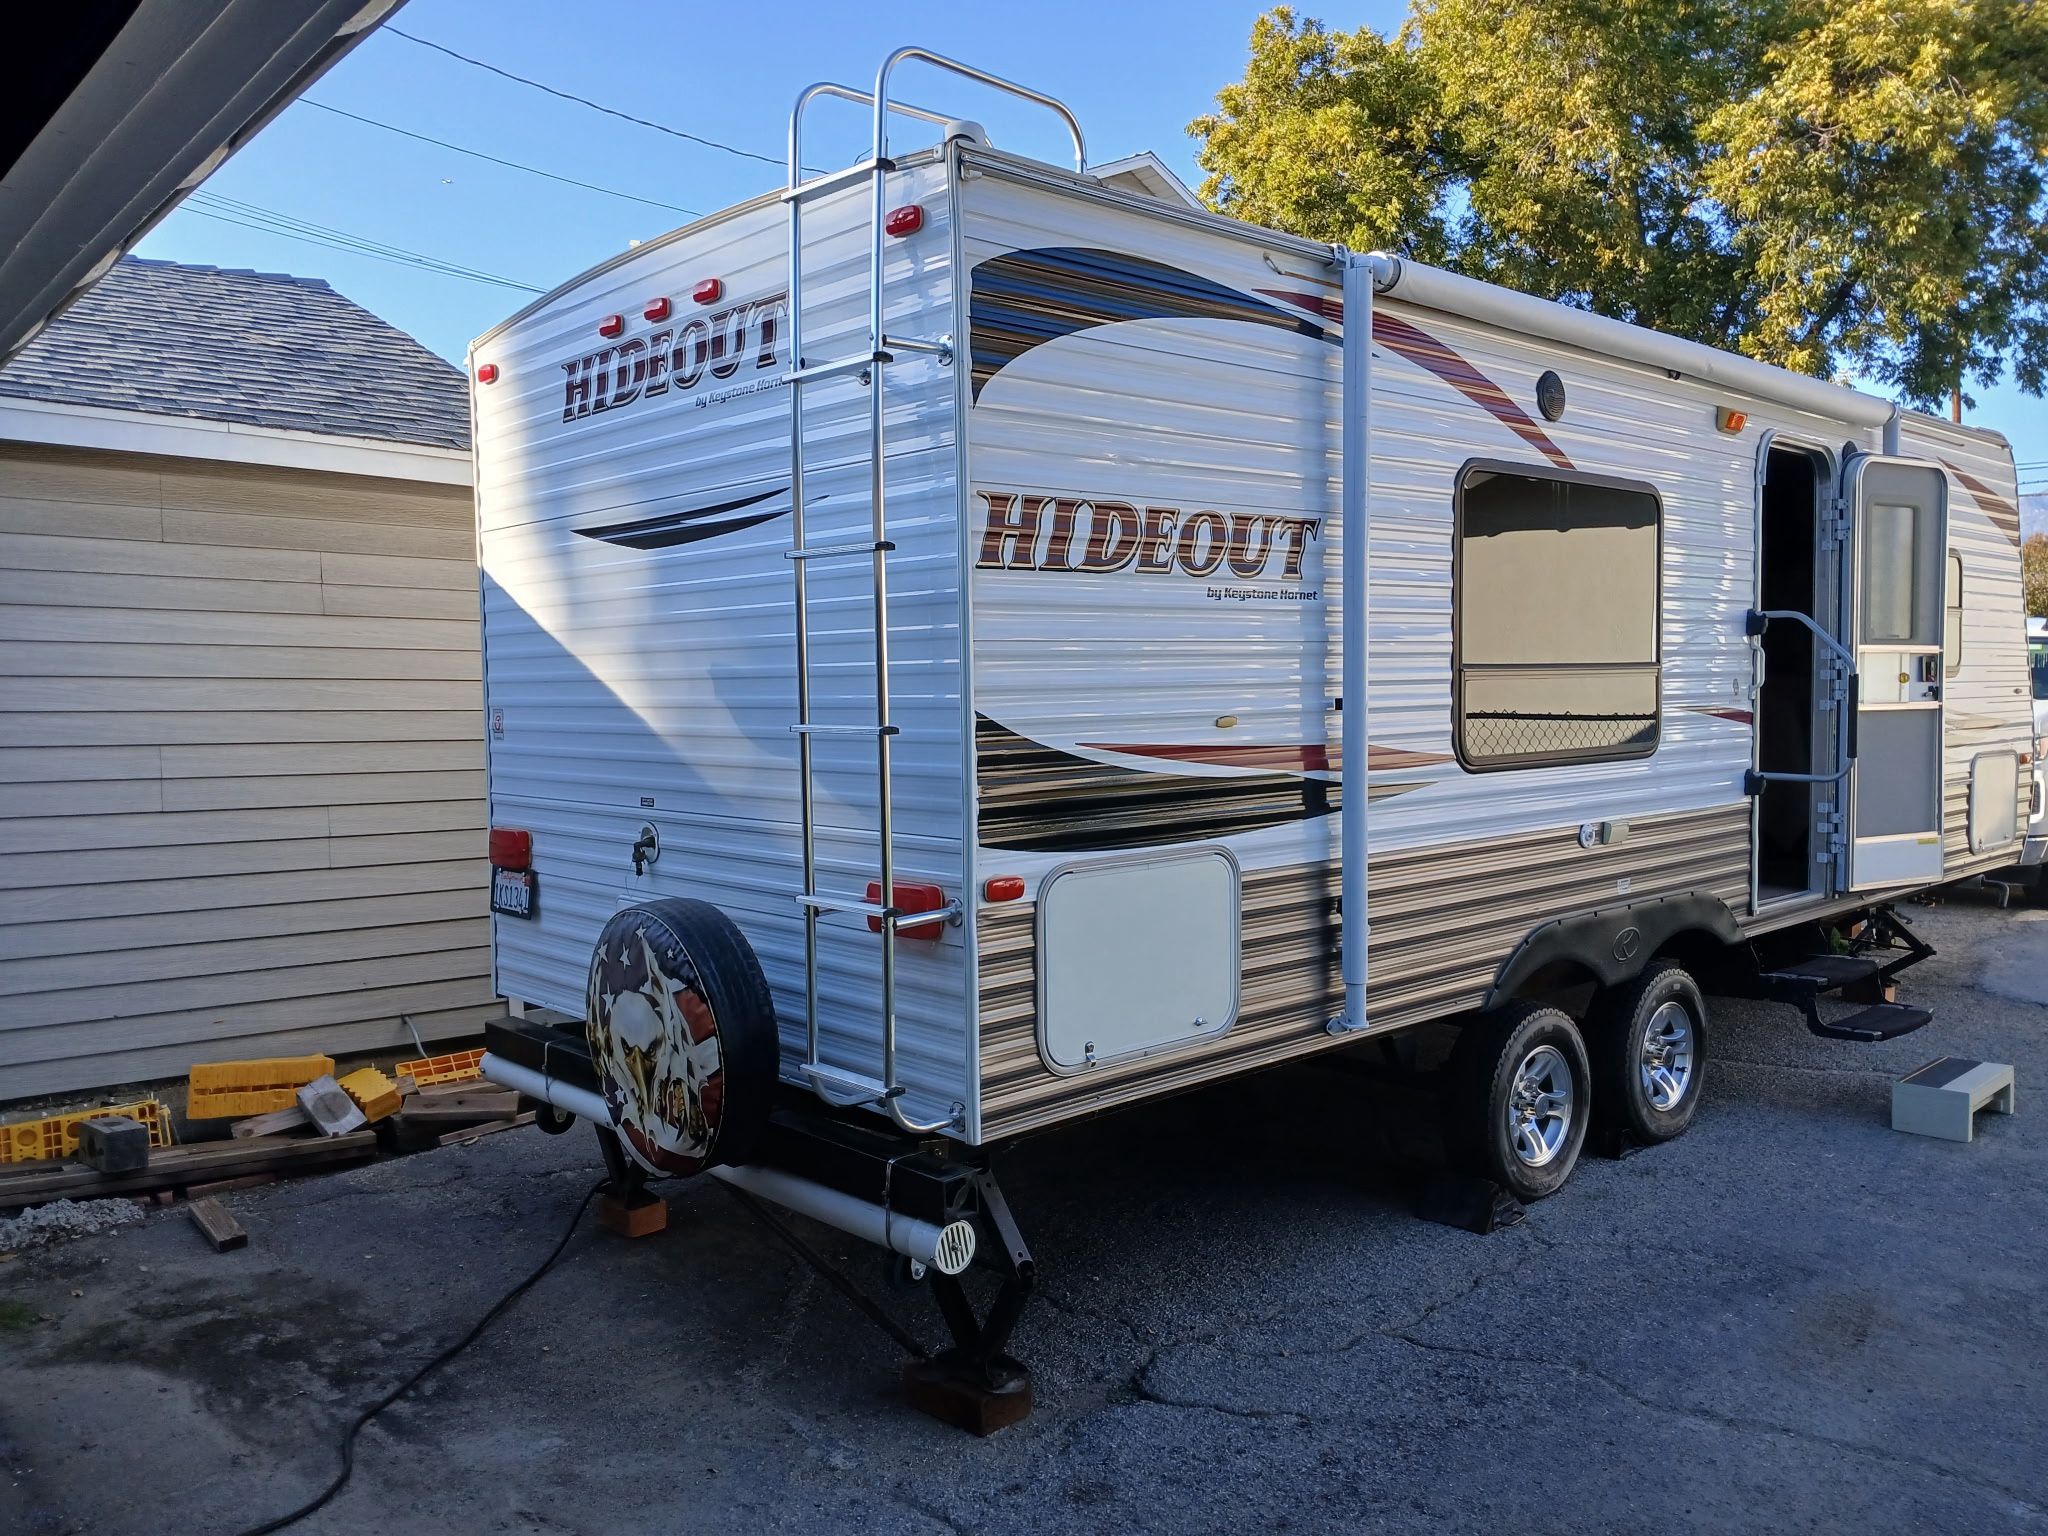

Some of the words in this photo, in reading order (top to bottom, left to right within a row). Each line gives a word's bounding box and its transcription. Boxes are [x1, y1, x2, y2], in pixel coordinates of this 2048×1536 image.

[561, 290, 790, 424] HIDEOUT
[695, 395, 708, 409] by
[709, 384, 755, 404] Keystone
[756, 376, 784, 392] Horn
[975, 489, 1322, 580] HIDEOUT
[1206, 586, 1222, 601] by
[1224, 587, 1278, 602] Keystone
[1280, 589, 1318, 601] Hornet
